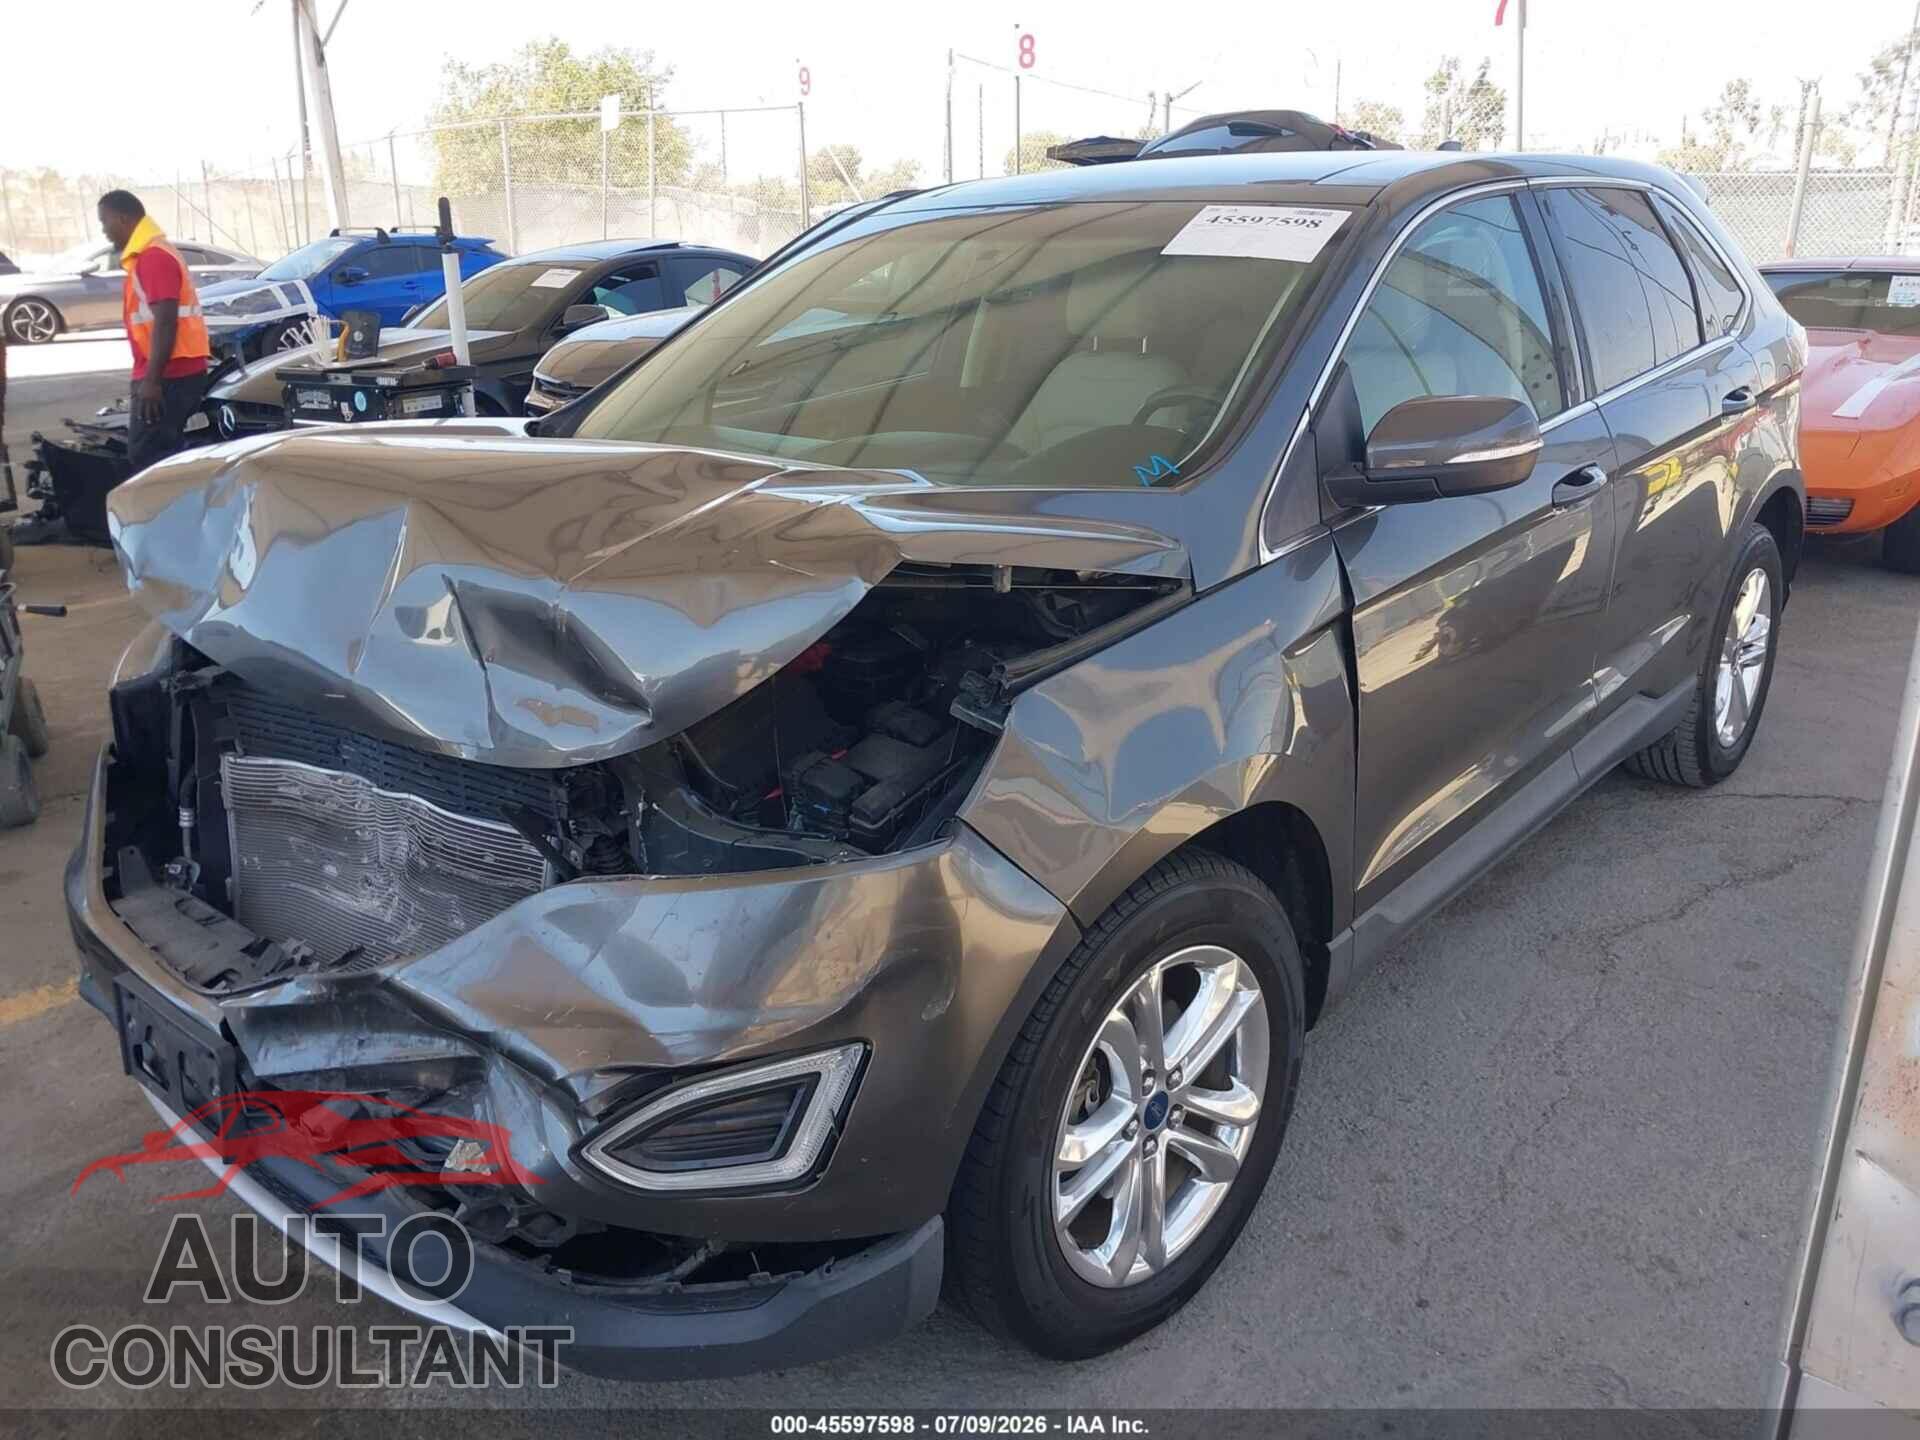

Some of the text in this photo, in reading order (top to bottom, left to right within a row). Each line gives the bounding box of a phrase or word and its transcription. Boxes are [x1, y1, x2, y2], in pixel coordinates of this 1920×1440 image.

[1018, 33, 1036, 69] 8
[798, 66, 811, 96] 9
[1205, 214, 1323, 229] 45597598
